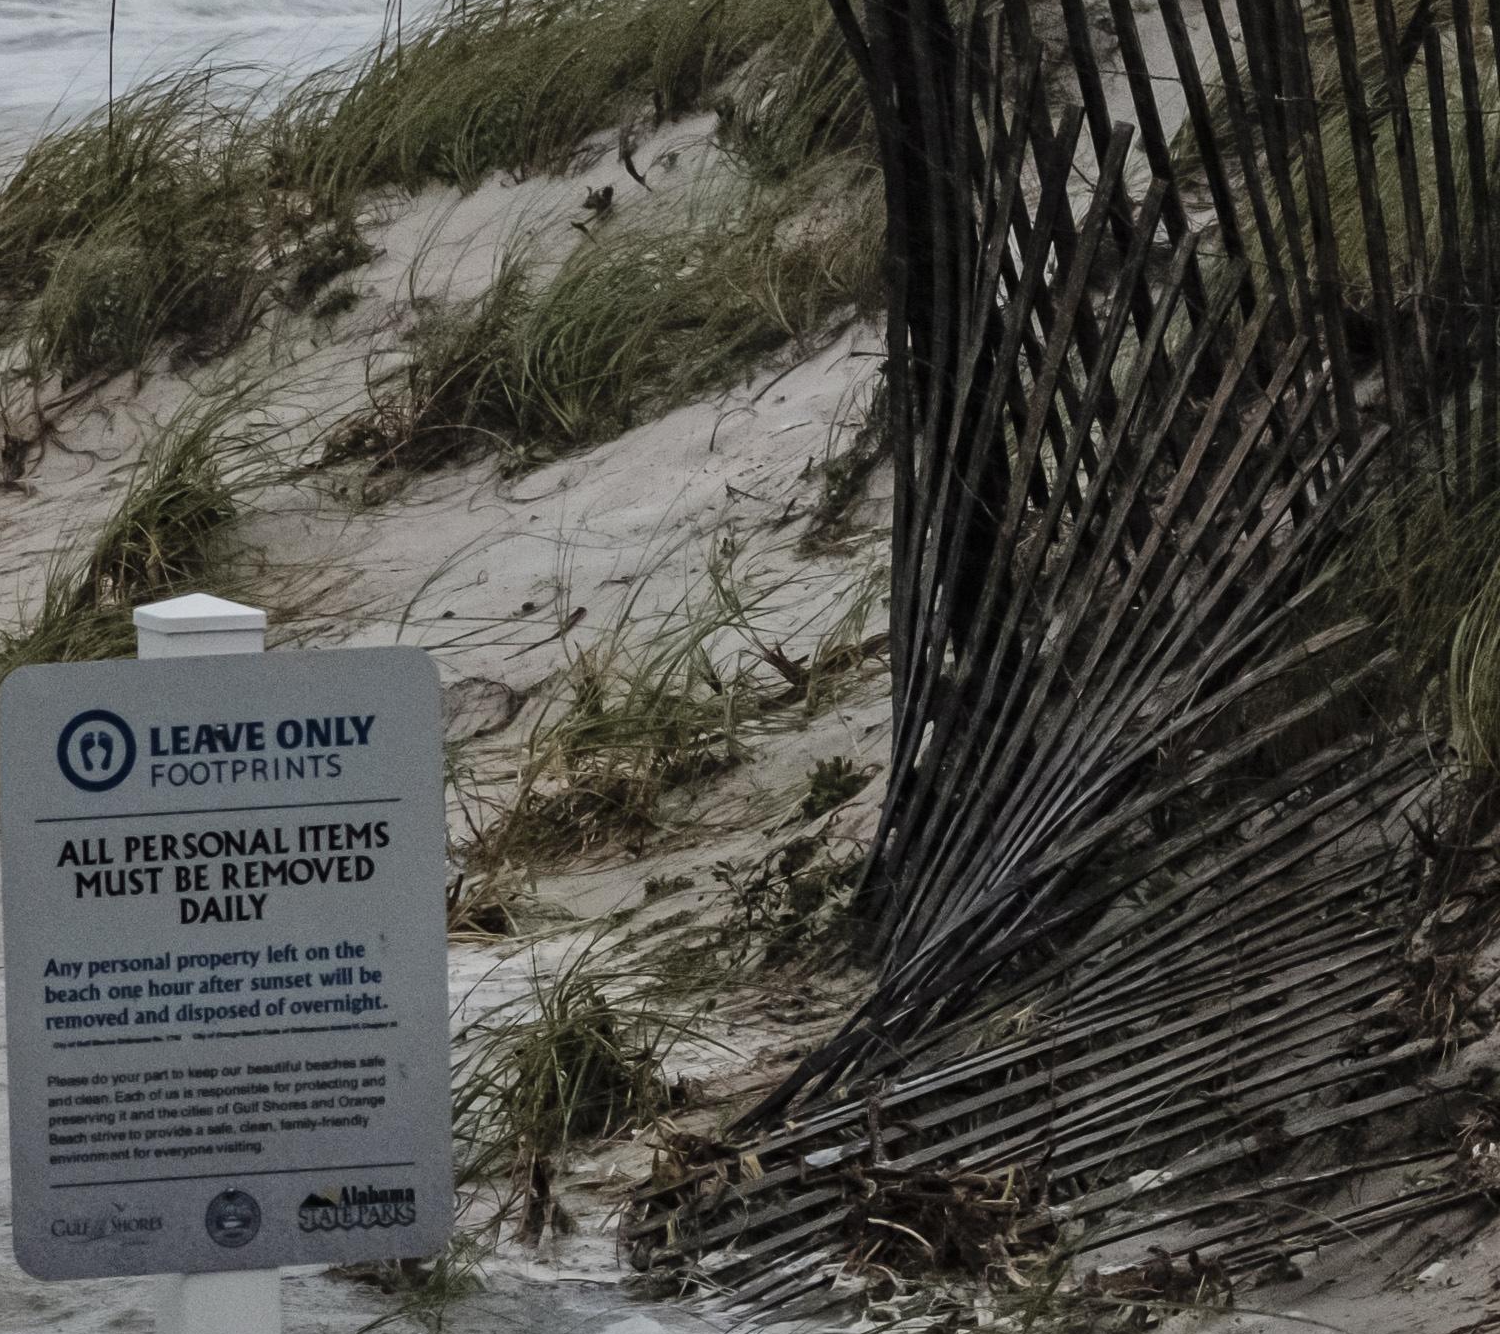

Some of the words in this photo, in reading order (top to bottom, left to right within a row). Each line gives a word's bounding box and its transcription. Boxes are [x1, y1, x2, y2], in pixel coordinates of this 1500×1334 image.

[151, 721, 264, 756] LEAVE
[277, 715, 376, 749] ONLY
[151, 753, 342, 787] FOOTPRINTS
[57, 839, 113, 867] ALL
[125, 828, 288, 863] PERSONAL
[299, 821, 390, 853] ITEMS
[75, 866, 163, 898] MUST
[175, 864, 210, 892] BE
[222, 856, 375, 890] REMOVED
[180, 894, 268, 924] DAILY
[44, 958, 83, 979] Any
[87, 953, 171, 979] personal
[177, 949, 260, 978] property
[267, 944, 297, 963] left
[305, 946, 329, 961] on
[335, 941, 365, 960] the
[45, 984, 100, 1004] beach
[108, 984, 143, 1000] one
[148, 978, 194, 997] hour
[198, 974, 243, 995] after
[250, 972, 312, 991] sunset
[319, 968, 354, 987] will
[359, 966, 382, 985] be
[45, 1007, 129, 1030] removed
[134, 1004, 170, 1025] and
[176, 1000, 261, 1024] disposed
[265, 997, 285, 1016] of
[290, 992, 388, 1016] overnight.
[47, 1074, 88, 1087] Please
[91, 1073, 108, 1085] do
[111, 1072, 140, 1086] your
[144, 1070, 168, 1083] part
[172, 1069, 184, 1079] to
[188, 1066, 218, 1079] keep
[221, 1066, 242, 1077] our
[247, 1060, 301, 1075] beautiful
[305, 1057, 357, 1072] beaches
[360, 1055, 386, 1068] safe
[48, 1095, 72, 1108] and
[115, 1090, 145, 1104] Each
[149, 1089, 162, 1101] of
[165, 1089, 180, 1100] us
[183, 1088, 194, 1098] is
[197, 1083, 270, 1099] responsible
[273, 1081, 291, 1093] for
[294, 1078, 358, 1094] protecting
[362, 1075, 386, 1088] and
[48, 1112, 116, 1128] preserving
[119, 1110, 127, 1121] it
[130, 1108, 155, 1121] and
[158, 1106, 178, 1119] the
[180, 1104, 213, 1118] cities
[217, 1103, 229, 1115] of
[232, 1101, 260, 1115] Gulf
[262, 1099, 307, 1113] Shores
[311, 1097, 334, 1109] and
[338, 1095, 386, 1109] Orange
[49, 1131, 88, 1145] Beach
[90, 1129, 126, 1143] strive
[128, 1128, 142, 1140] to
[144, 1125, 193, 1142] provide
[195, 1126, 203, 1136] a
[280, 1113, 369, 1132] family-friendly
[50, 1149, 130, 1165] environment
[133, 1147, 151, 1159] for
[154, 1143, 213, 1159] everyone
[216, 1140, 265, 1155] visiting.
[339, 1184, 415, 1206] Alabama
[299, 1207, 356, 1232] STATE
[358, 1203, 417, 1229] PARKS
